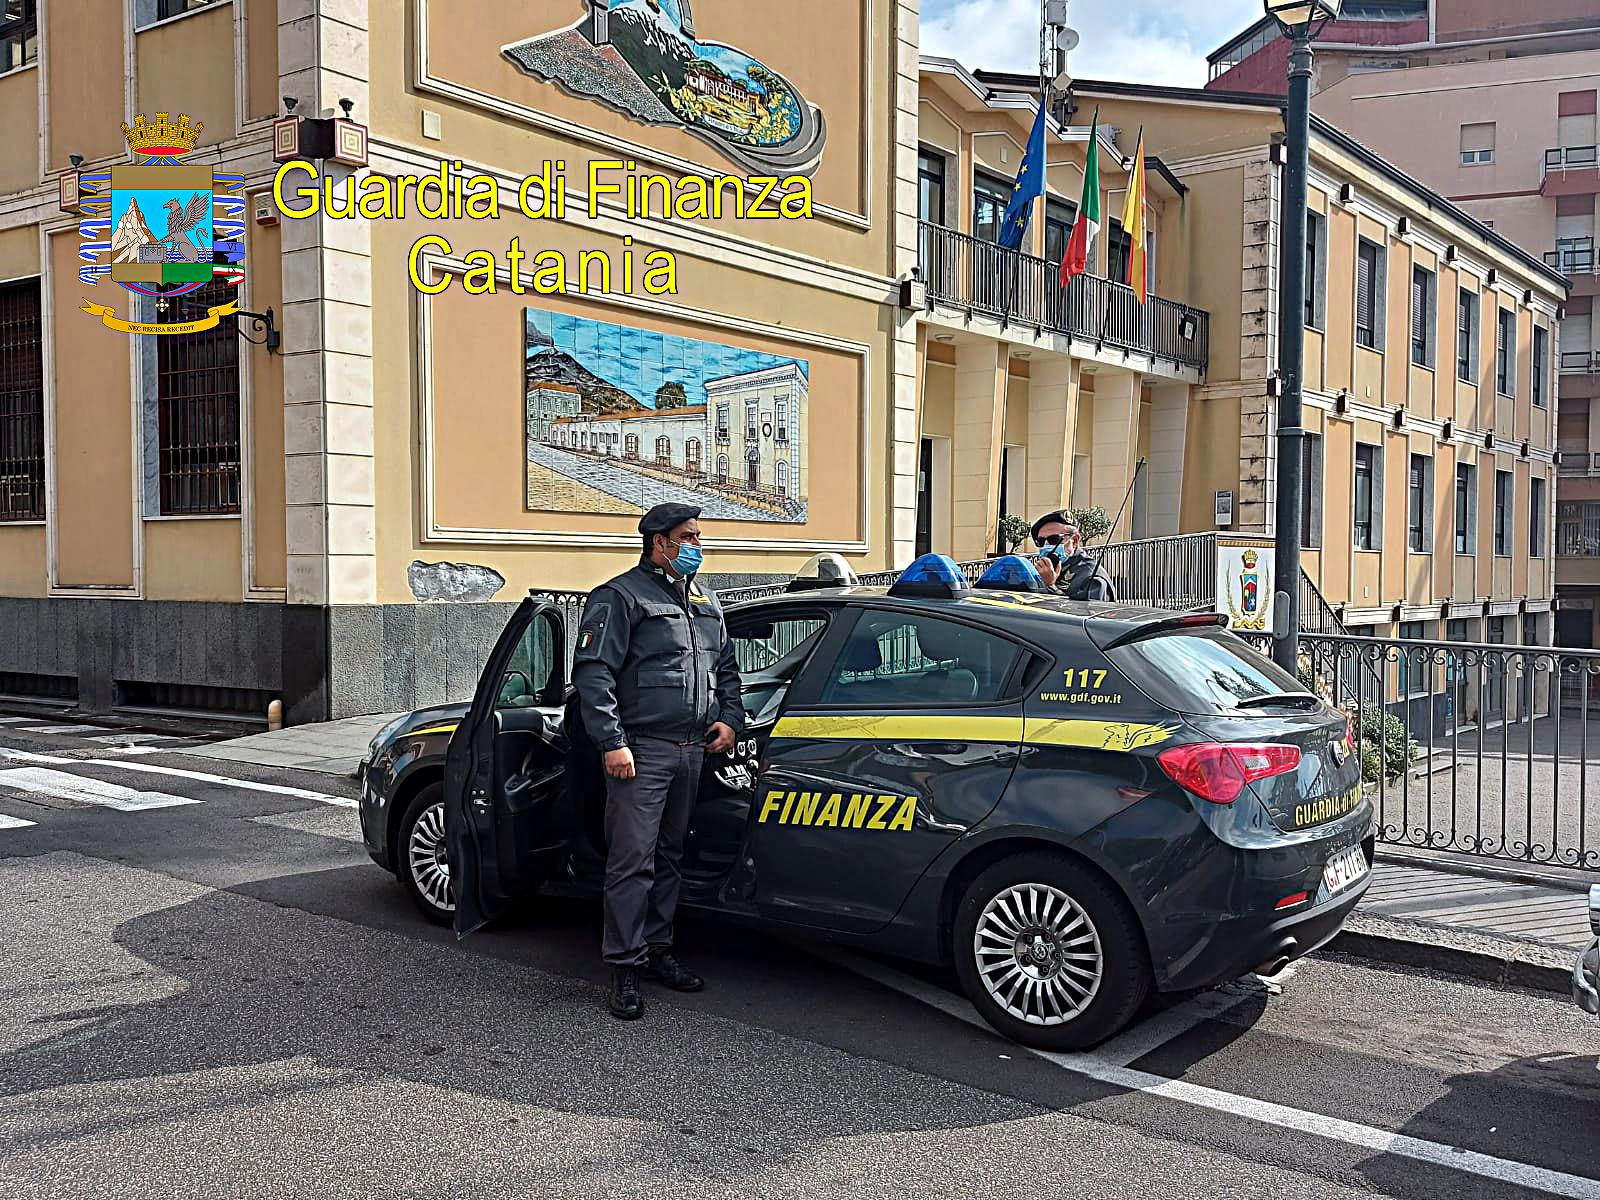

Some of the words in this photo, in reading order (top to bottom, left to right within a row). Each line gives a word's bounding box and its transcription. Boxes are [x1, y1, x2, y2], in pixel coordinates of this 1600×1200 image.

[1063, 668, 1108, 689] 117
[1040, 692, 1122, 704] www.gdf.gov.it
[758, 790, 918, 831] FINANZA
[1295, 795, 1341, 826] GUARDIA
